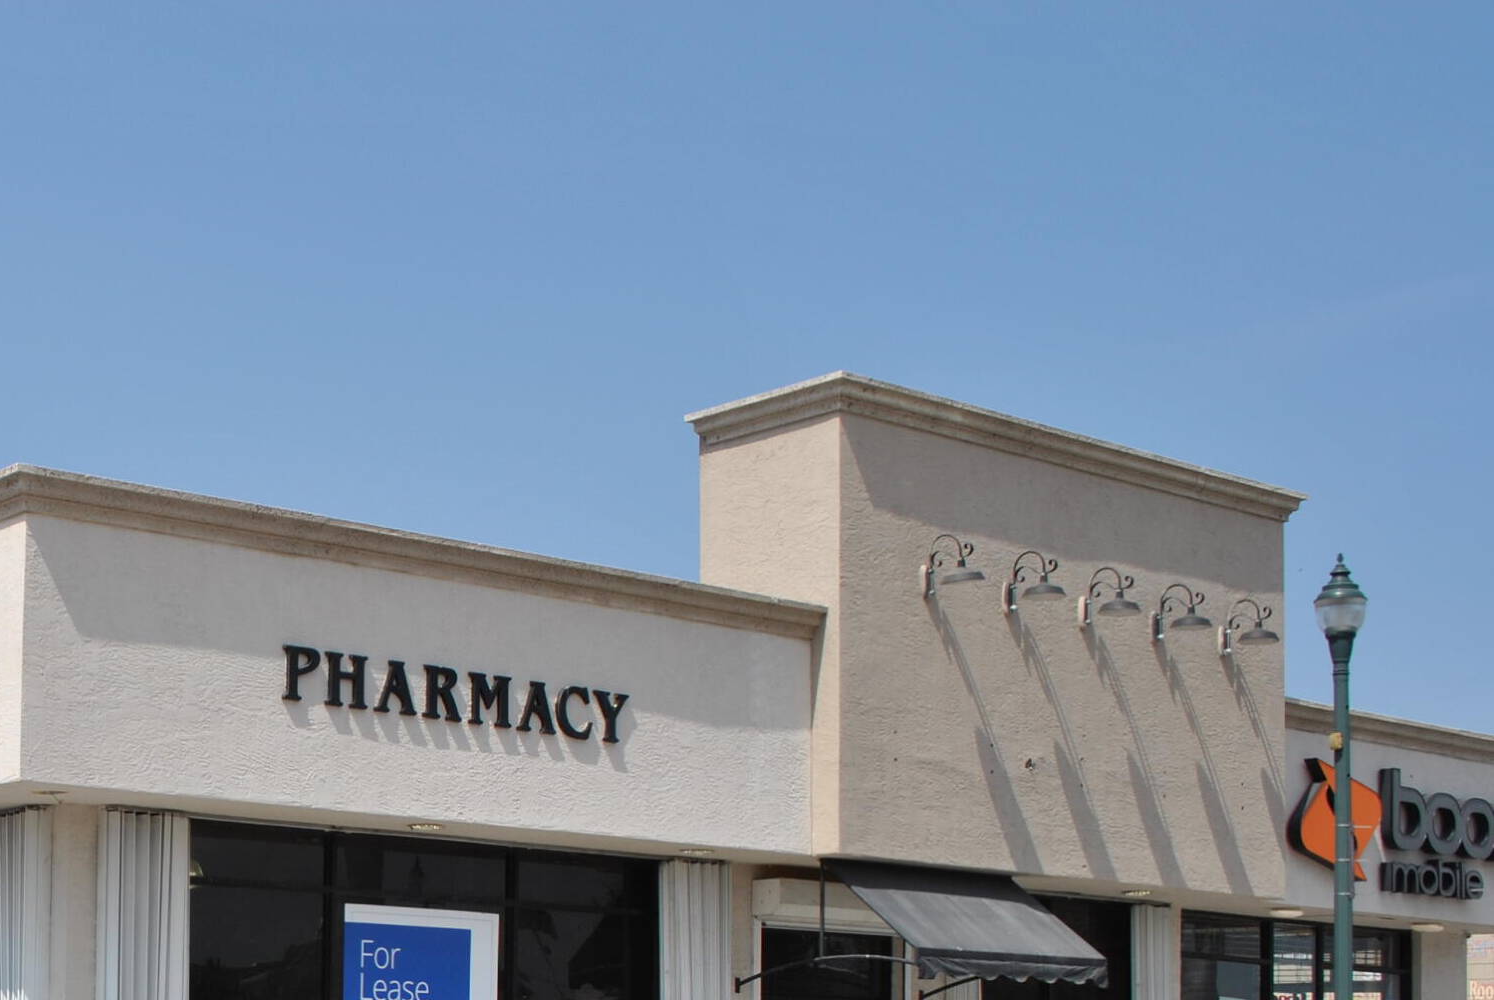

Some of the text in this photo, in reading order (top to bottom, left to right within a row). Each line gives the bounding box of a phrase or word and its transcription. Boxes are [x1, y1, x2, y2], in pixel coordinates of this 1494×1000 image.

[282, 644, 630, 743] PHARMACY
[1379, 859, 1483, 899] mobile
[360, 940, 400, 970] For
